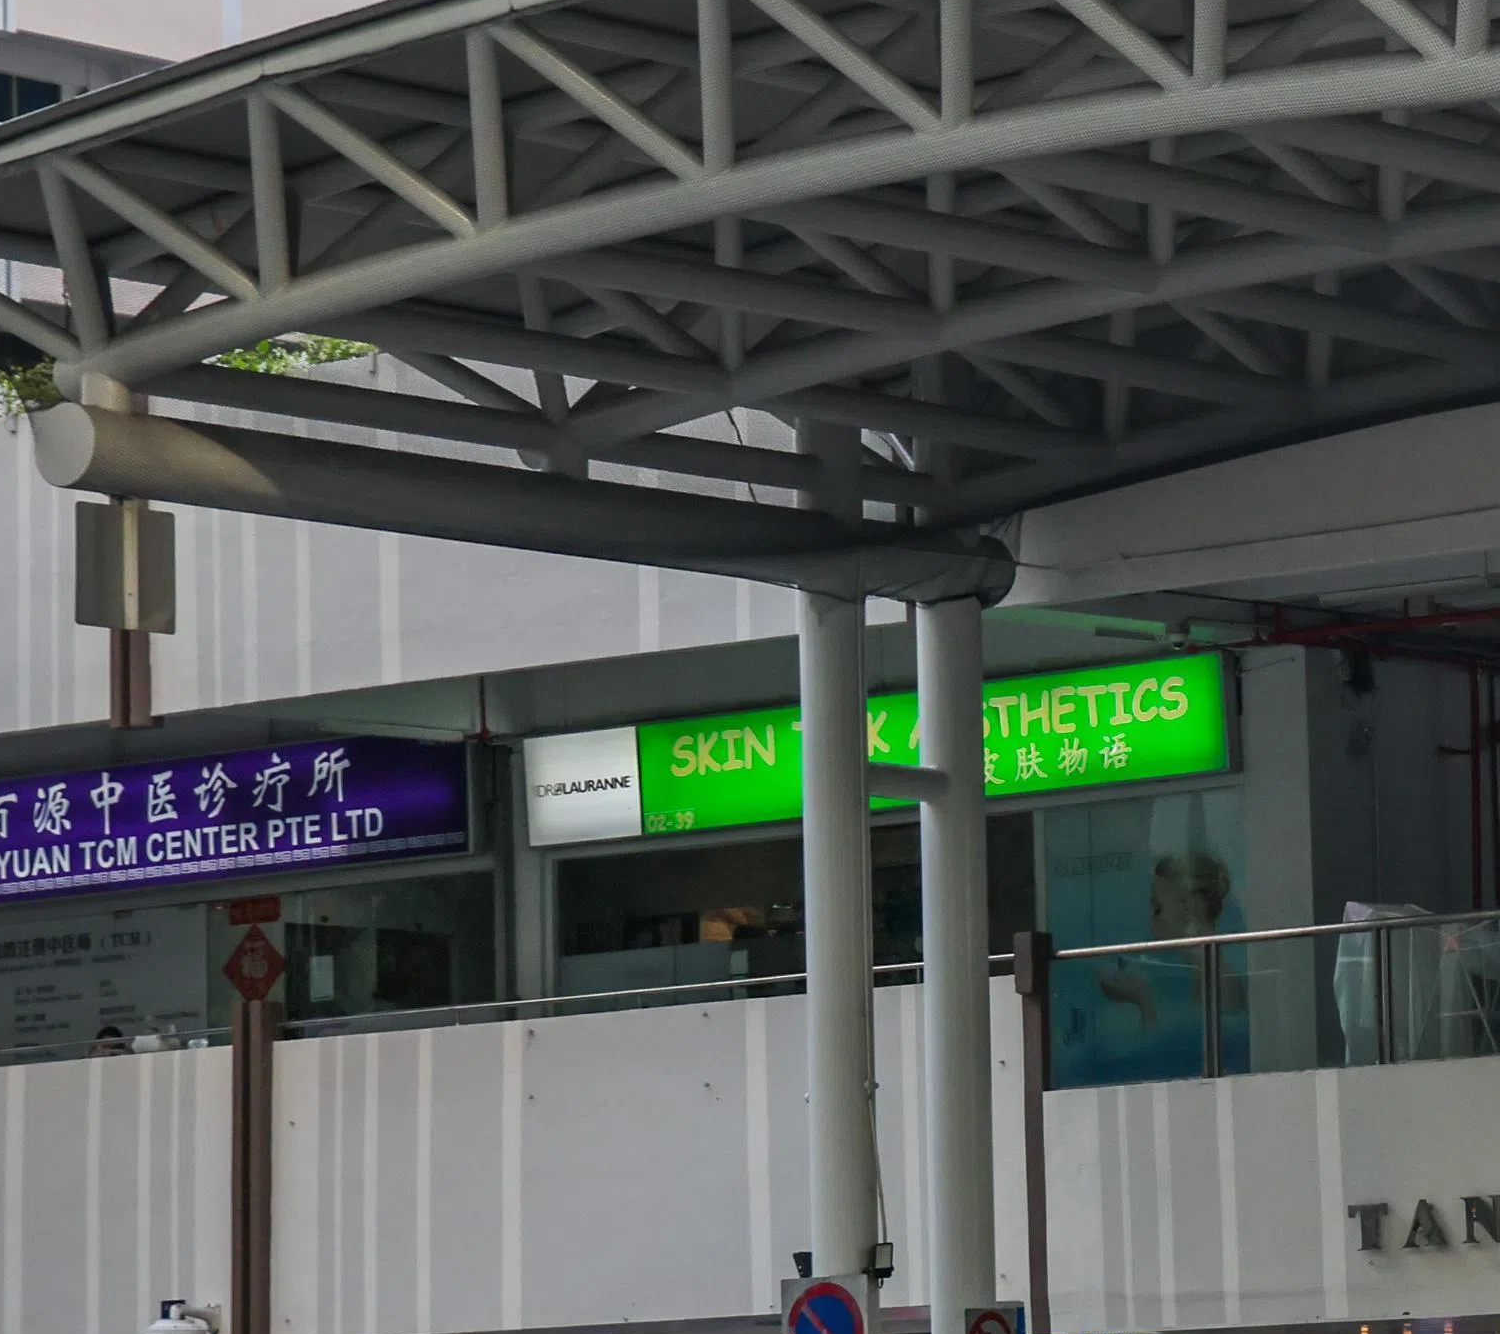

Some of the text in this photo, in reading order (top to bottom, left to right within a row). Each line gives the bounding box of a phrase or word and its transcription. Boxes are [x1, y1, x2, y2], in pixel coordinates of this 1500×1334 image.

[670, 724, 776, 778] SKIN
[78, 838, 138, 869] TCM
[145, 822, 259, 862] CENTER
[266, 814, 321, 851] PTE
[330, 806, 384, 841] LTD
